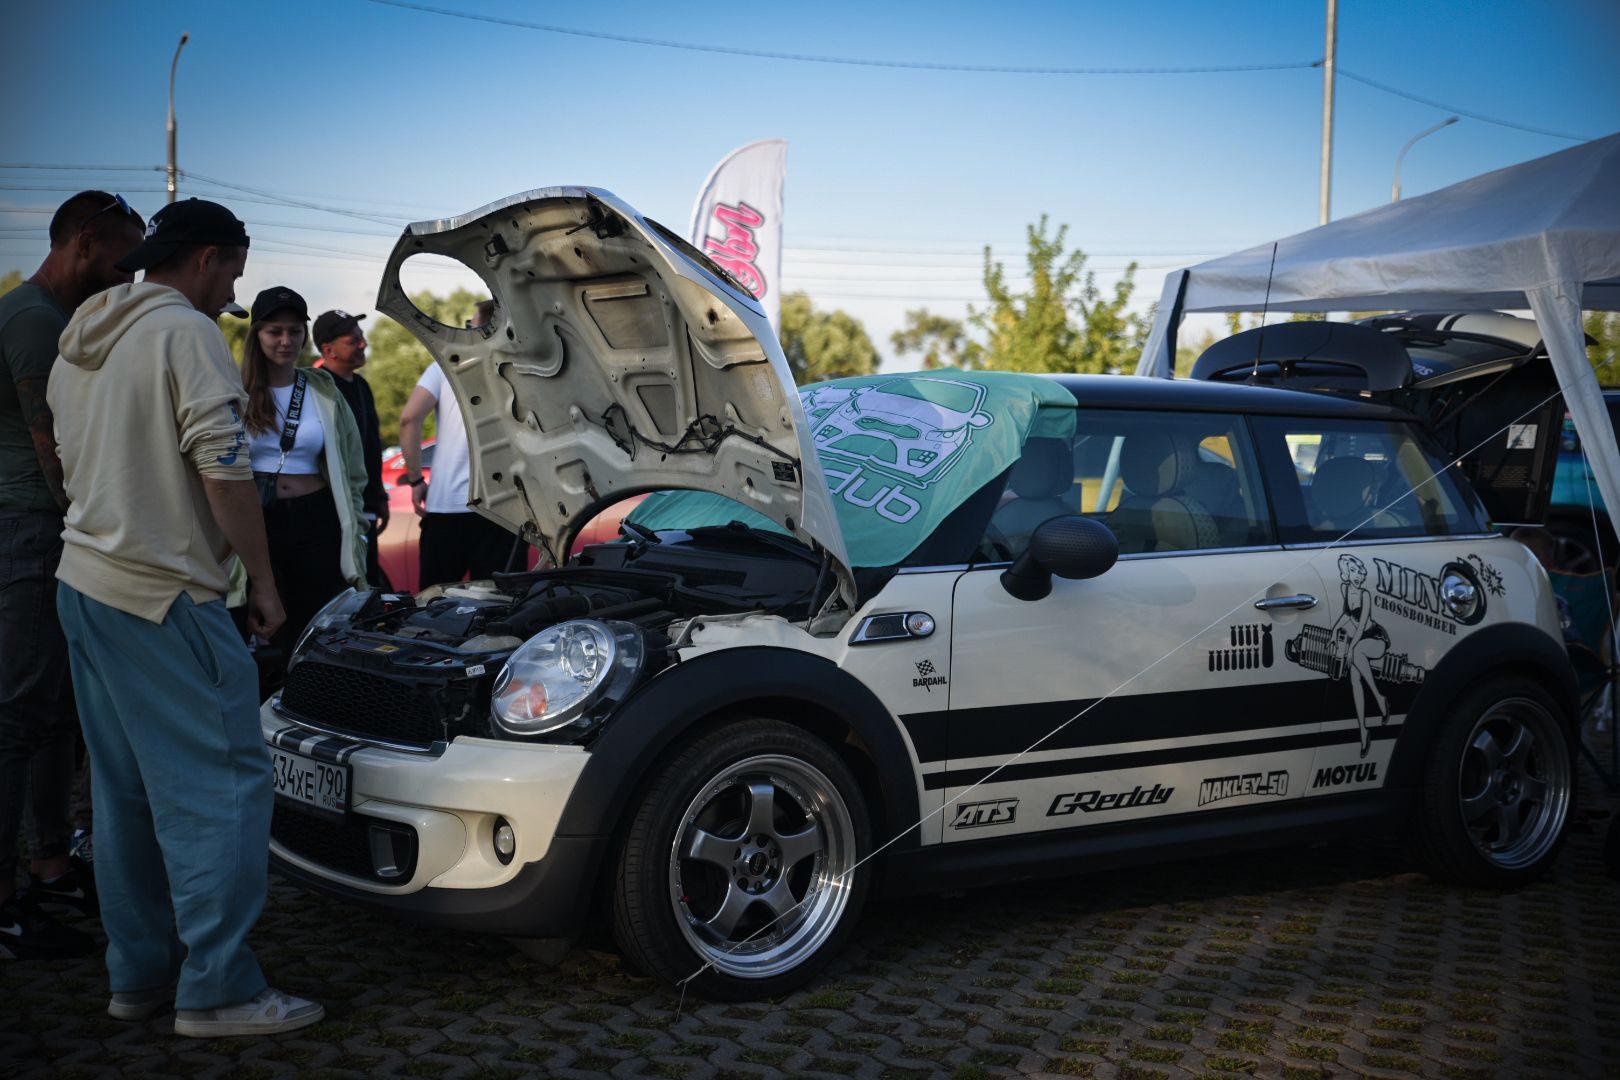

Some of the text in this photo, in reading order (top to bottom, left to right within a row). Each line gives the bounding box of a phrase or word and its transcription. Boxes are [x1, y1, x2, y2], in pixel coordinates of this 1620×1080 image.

[1373, 557, 1455, 619] MIN
[1374, 595, 1457, 636] CROSSBOMBER
[912, 676, 948, 688] BARDAHL
[317, 764, 344, 797] 790
[1198, 769, 1290, 807] NAKLEY_50
[1312, 762, 1378, 789] MOTUL
[322, 794, 336, 808] RUS
[949, 799, 1020, 828] ATS
[1045, 783, 1176, 817] GReddy
